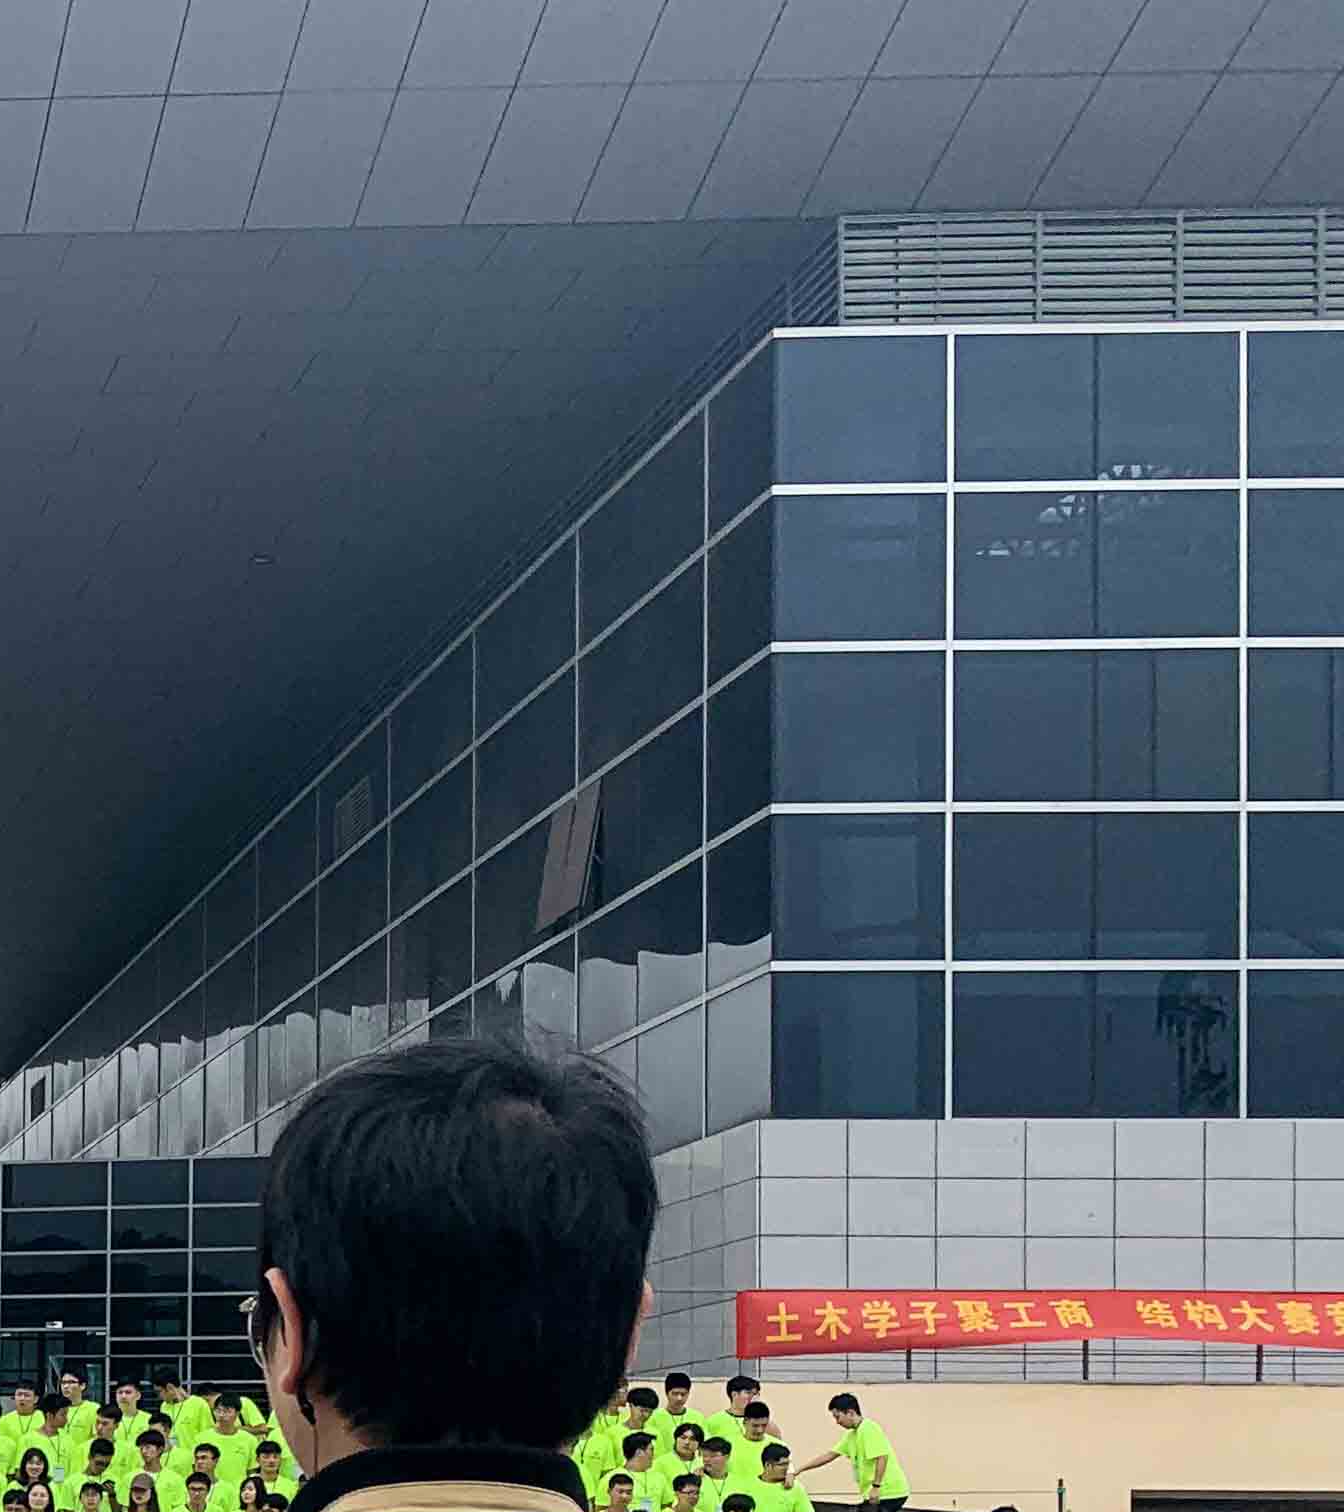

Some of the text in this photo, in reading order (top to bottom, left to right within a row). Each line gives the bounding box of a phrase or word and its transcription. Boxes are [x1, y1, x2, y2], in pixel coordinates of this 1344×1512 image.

[766, 1299, 1097, 1343] 土木学子聚工商
